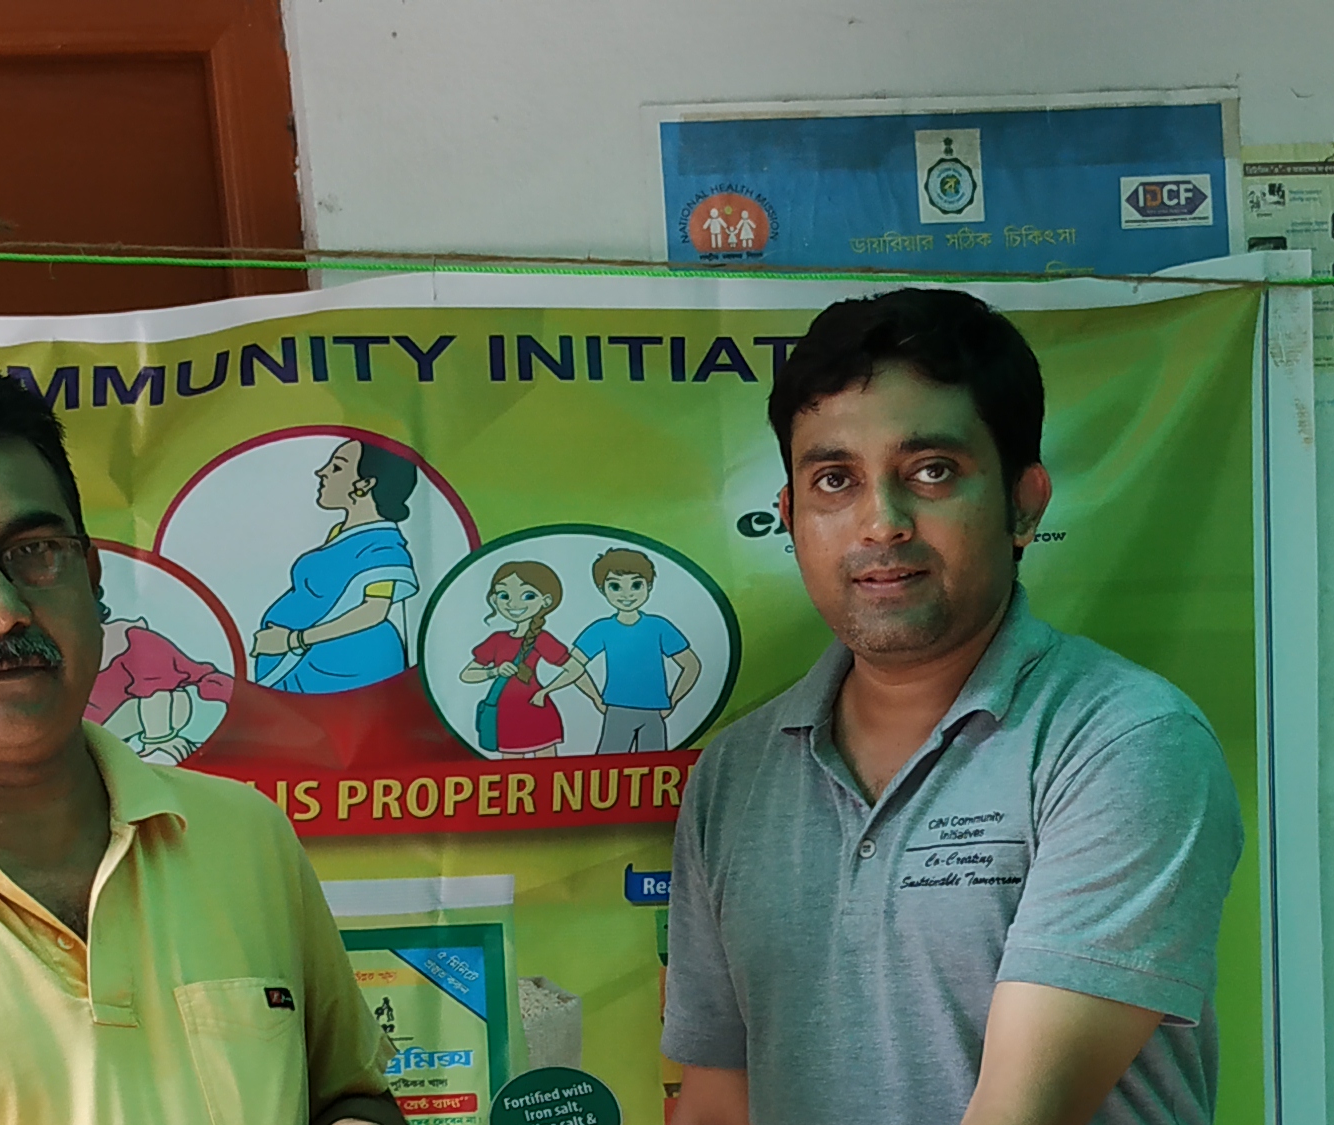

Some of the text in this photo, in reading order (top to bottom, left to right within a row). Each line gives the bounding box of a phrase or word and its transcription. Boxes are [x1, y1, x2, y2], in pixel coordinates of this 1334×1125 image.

[1137, 184, 1194, 207] IDCF
[678, 183, 779, 243] NATIONAL HEALTH MISSION
[945, 226, 992, 249] সঠিক
[1003, 224, 1077, 248] চিকিৎসা
[489, 334, 805, 382] INITIAT
[337, 772, 536, 820] PROPER
[950, 811, 1005, 829] Community
[503, 1081, 593, 1110] Fortified with
[524, 1100, 584, 1122] Iron salt,
[586, 1112, 598, 1125] &
